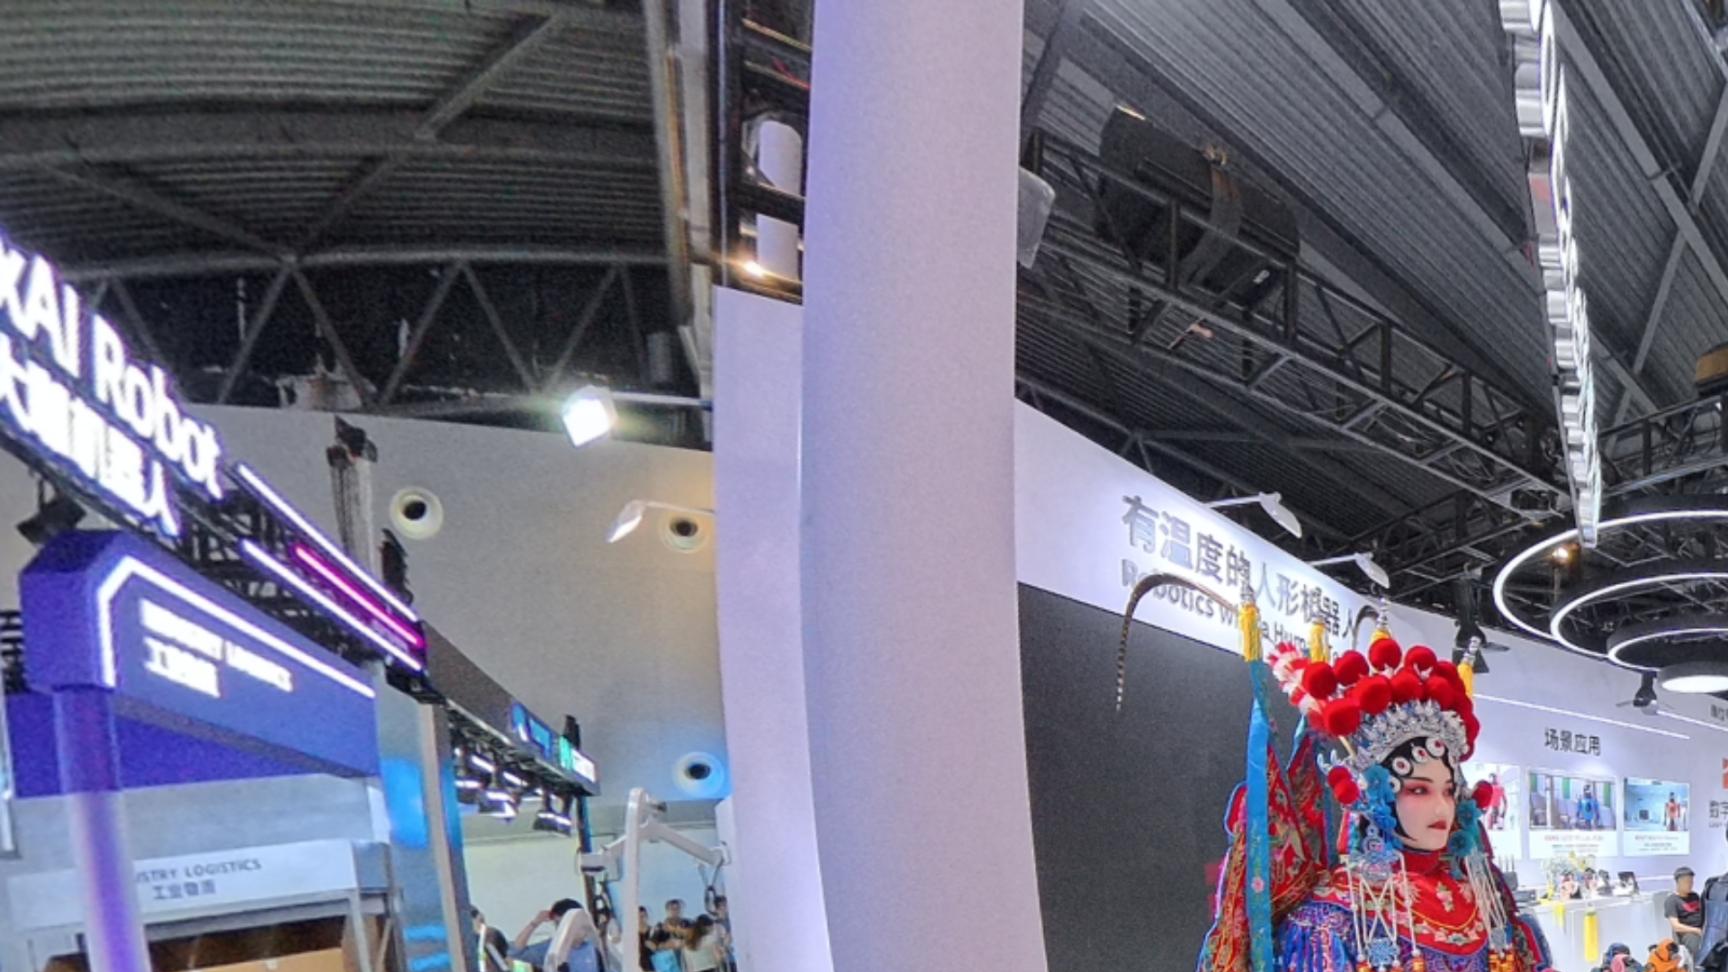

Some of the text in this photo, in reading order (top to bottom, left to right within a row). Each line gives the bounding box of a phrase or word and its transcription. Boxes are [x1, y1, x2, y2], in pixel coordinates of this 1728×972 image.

[93, 315, 222, 500] Robot
[1543, 726, 1602, 757] 场景应用
[185, 858, 262, 878] LOGISTICS
